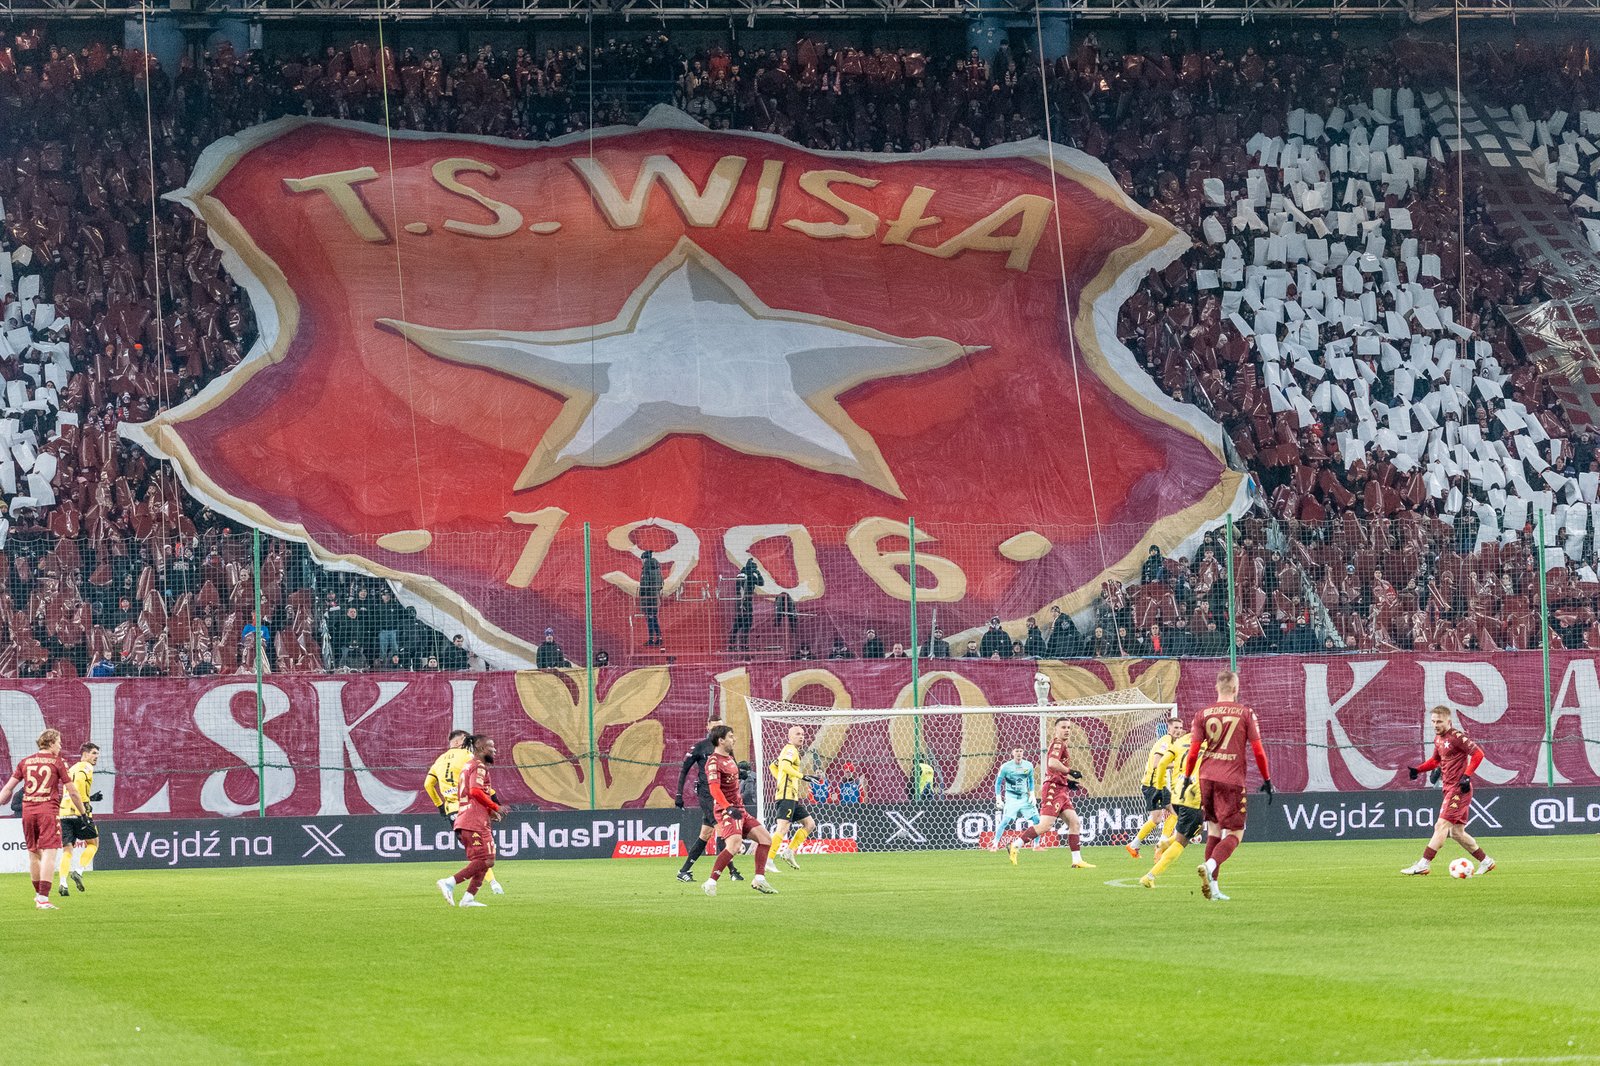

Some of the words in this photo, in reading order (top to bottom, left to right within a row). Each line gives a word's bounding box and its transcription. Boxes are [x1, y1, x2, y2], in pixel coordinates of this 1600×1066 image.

[283, 157, 561, 243] T.S.
[569, 153, 1054, 272] WISŁA
[504, 506, 968, 603] 1906
[1205, 716, 1241, 750] 97
[25, 765, 52, 794] 52
[786, 808, 793, 818] 2
[1054, 802, 1061, 813] 9
[1283, 802, 1386, 837] Wejdź
[1395, 808, 1435, 828] na
[817, 822, 858, 841] na
[112, 829, 221, 865] Wejdź
[230, 835, 273, 856] na
[618, 844, 671, 856] SUPERBE
[776, 841, 830, 855] Btclic
